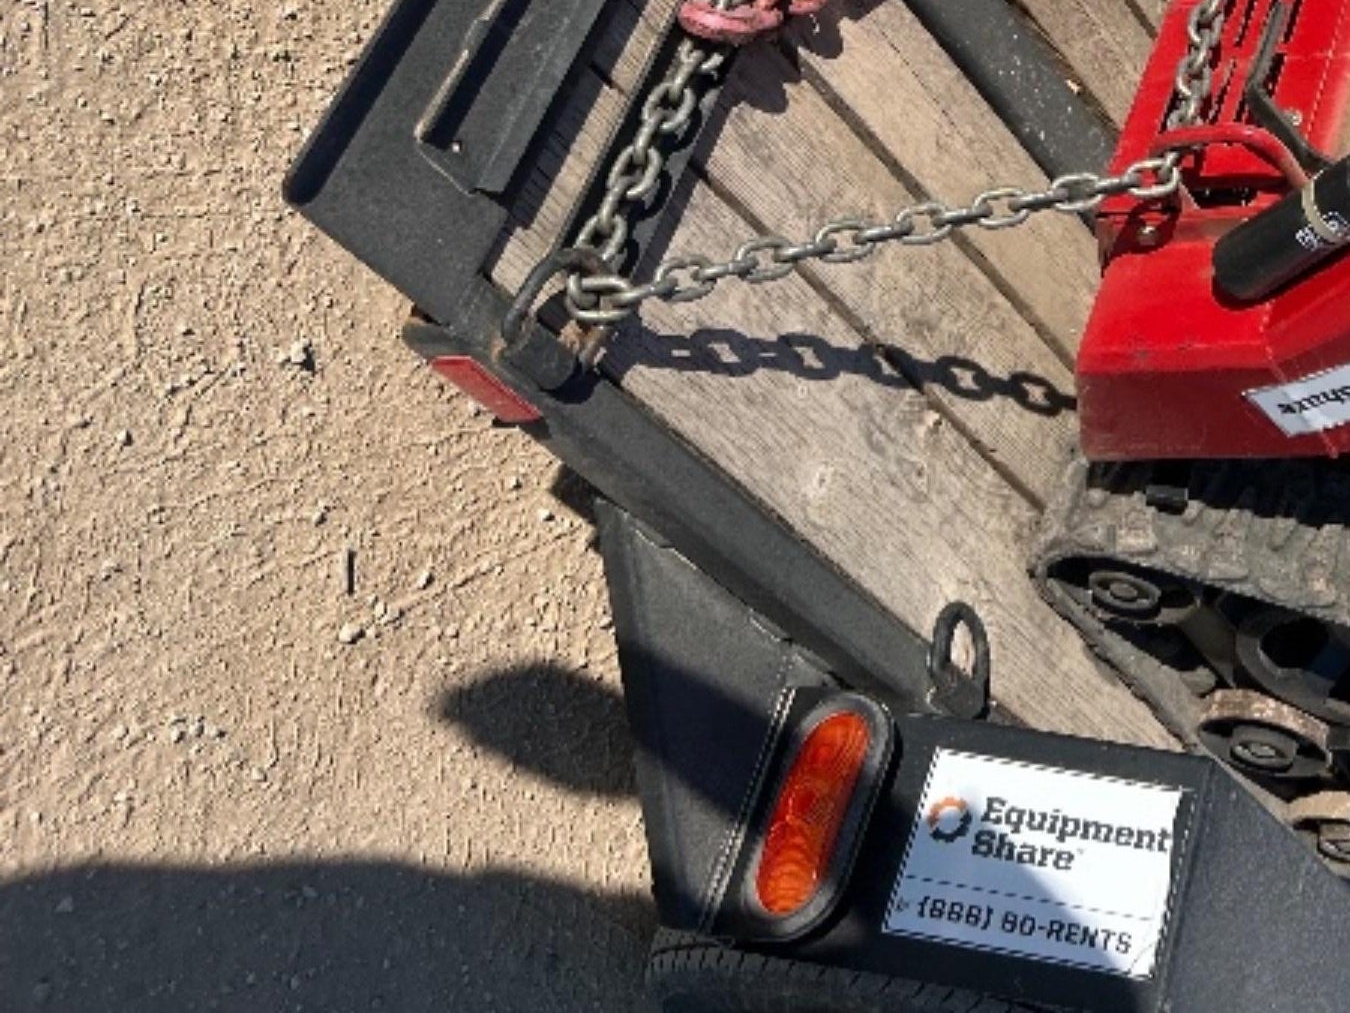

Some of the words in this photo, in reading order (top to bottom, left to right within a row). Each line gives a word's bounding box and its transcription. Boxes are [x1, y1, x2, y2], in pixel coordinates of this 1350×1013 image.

[970, 830, 1075, 871] Share
[979, 796, 1173, 854] Equipment
[916, 895, 994, 931] (888)
[1001, 910, 1133, 955] 80-RENTS
